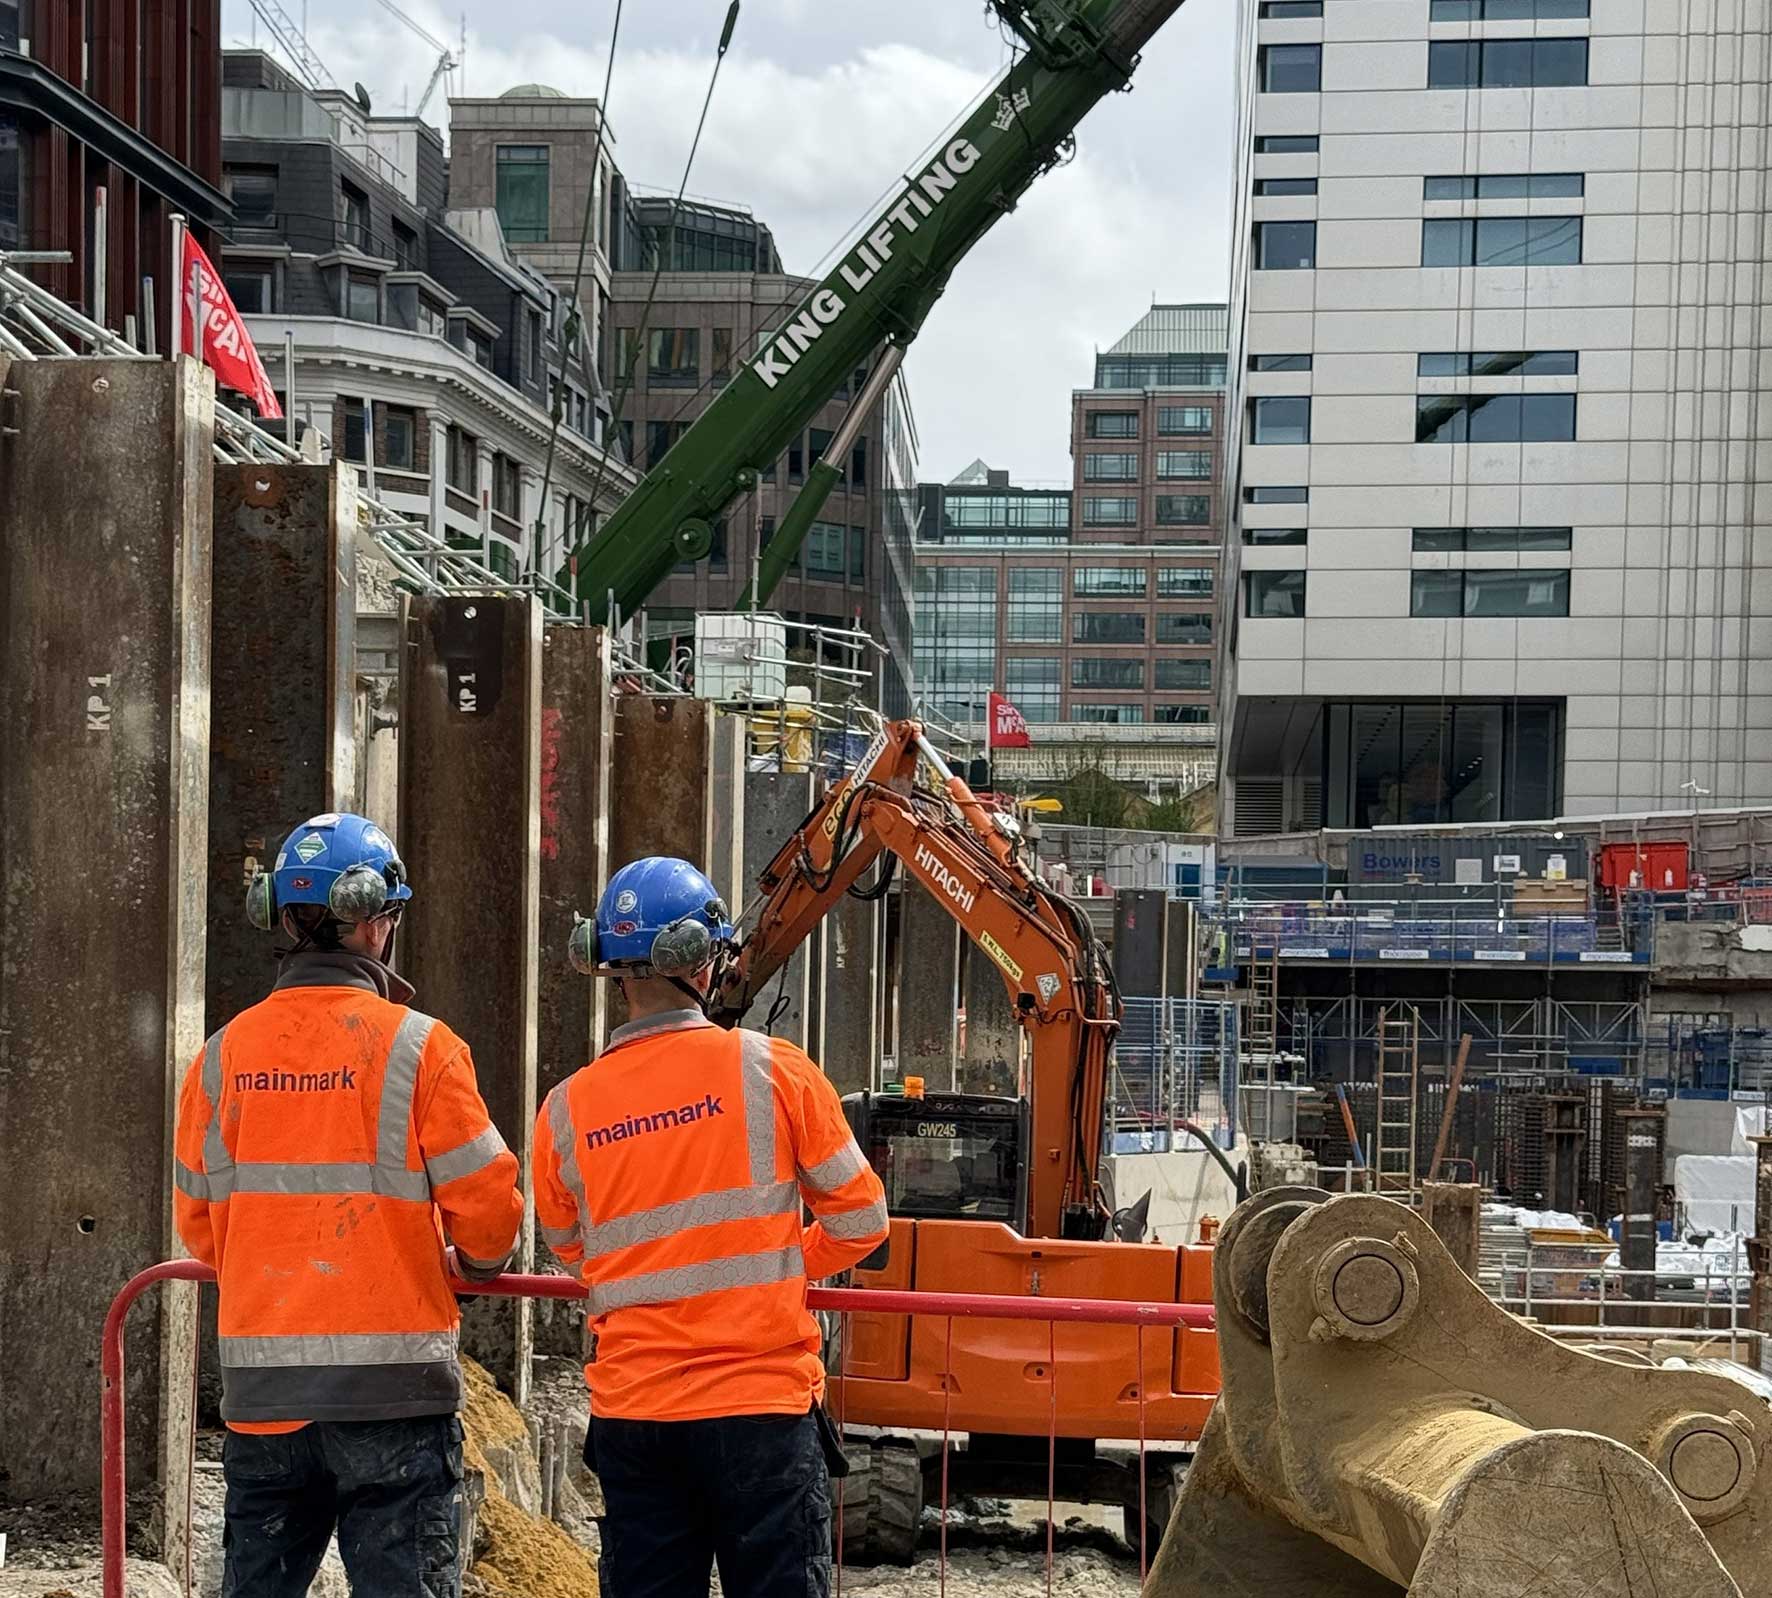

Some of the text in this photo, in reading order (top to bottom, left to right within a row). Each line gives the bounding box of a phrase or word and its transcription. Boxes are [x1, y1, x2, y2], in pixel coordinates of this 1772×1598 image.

[752, 138, 982, 390] KING LIFTING
[87, 695, 111, 730] KP
[459, 688, 477, 712] KP
[853, 737, 885, 786] HITACHI
[915, 843, 975, 913] HITACHI
[1363, 853, 1441, 869] Bowers
[234, 1064, 357, 1093] mainmark
[585, 1093, 725, 1151] mainmark
[917, 1122, 957, 1138] GW245
